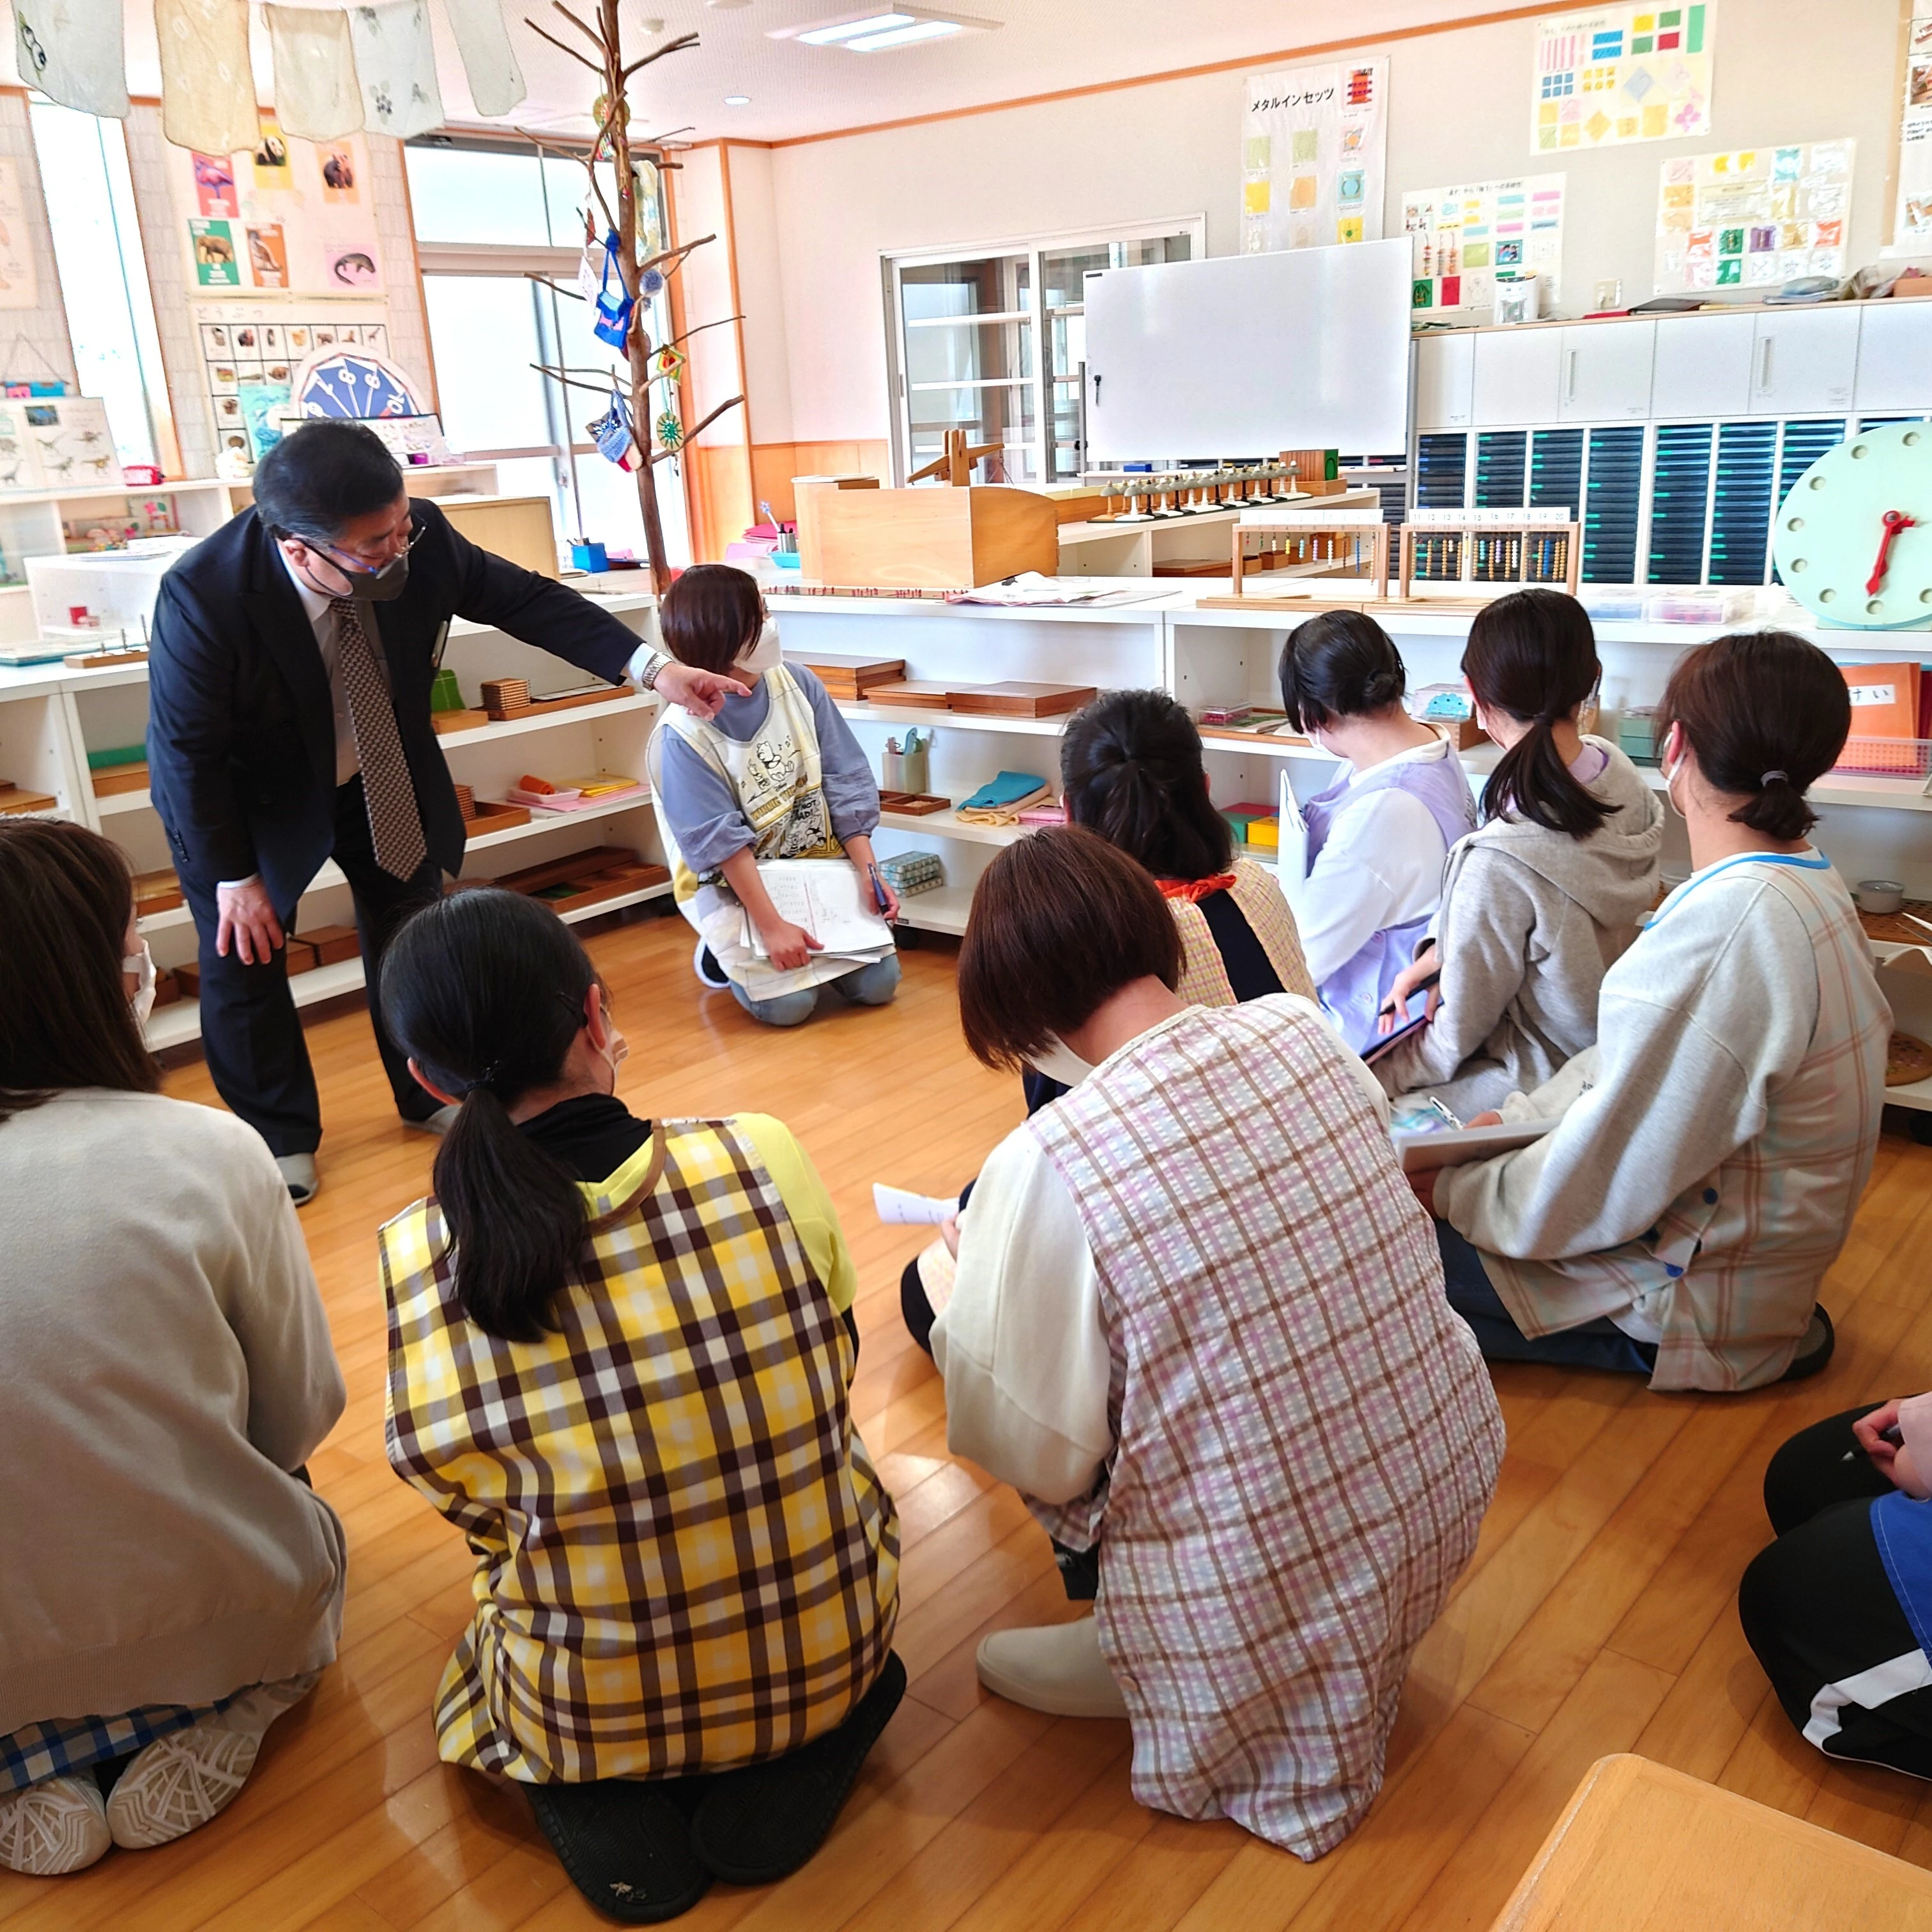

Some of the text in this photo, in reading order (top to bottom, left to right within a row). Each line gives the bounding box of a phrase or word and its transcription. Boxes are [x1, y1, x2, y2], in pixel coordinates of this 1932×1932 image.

[1252, 88, 1334, 112] メタルインセッツ
[338, 369, 356, 385] 8
[387, 394, 406, 415] 10
